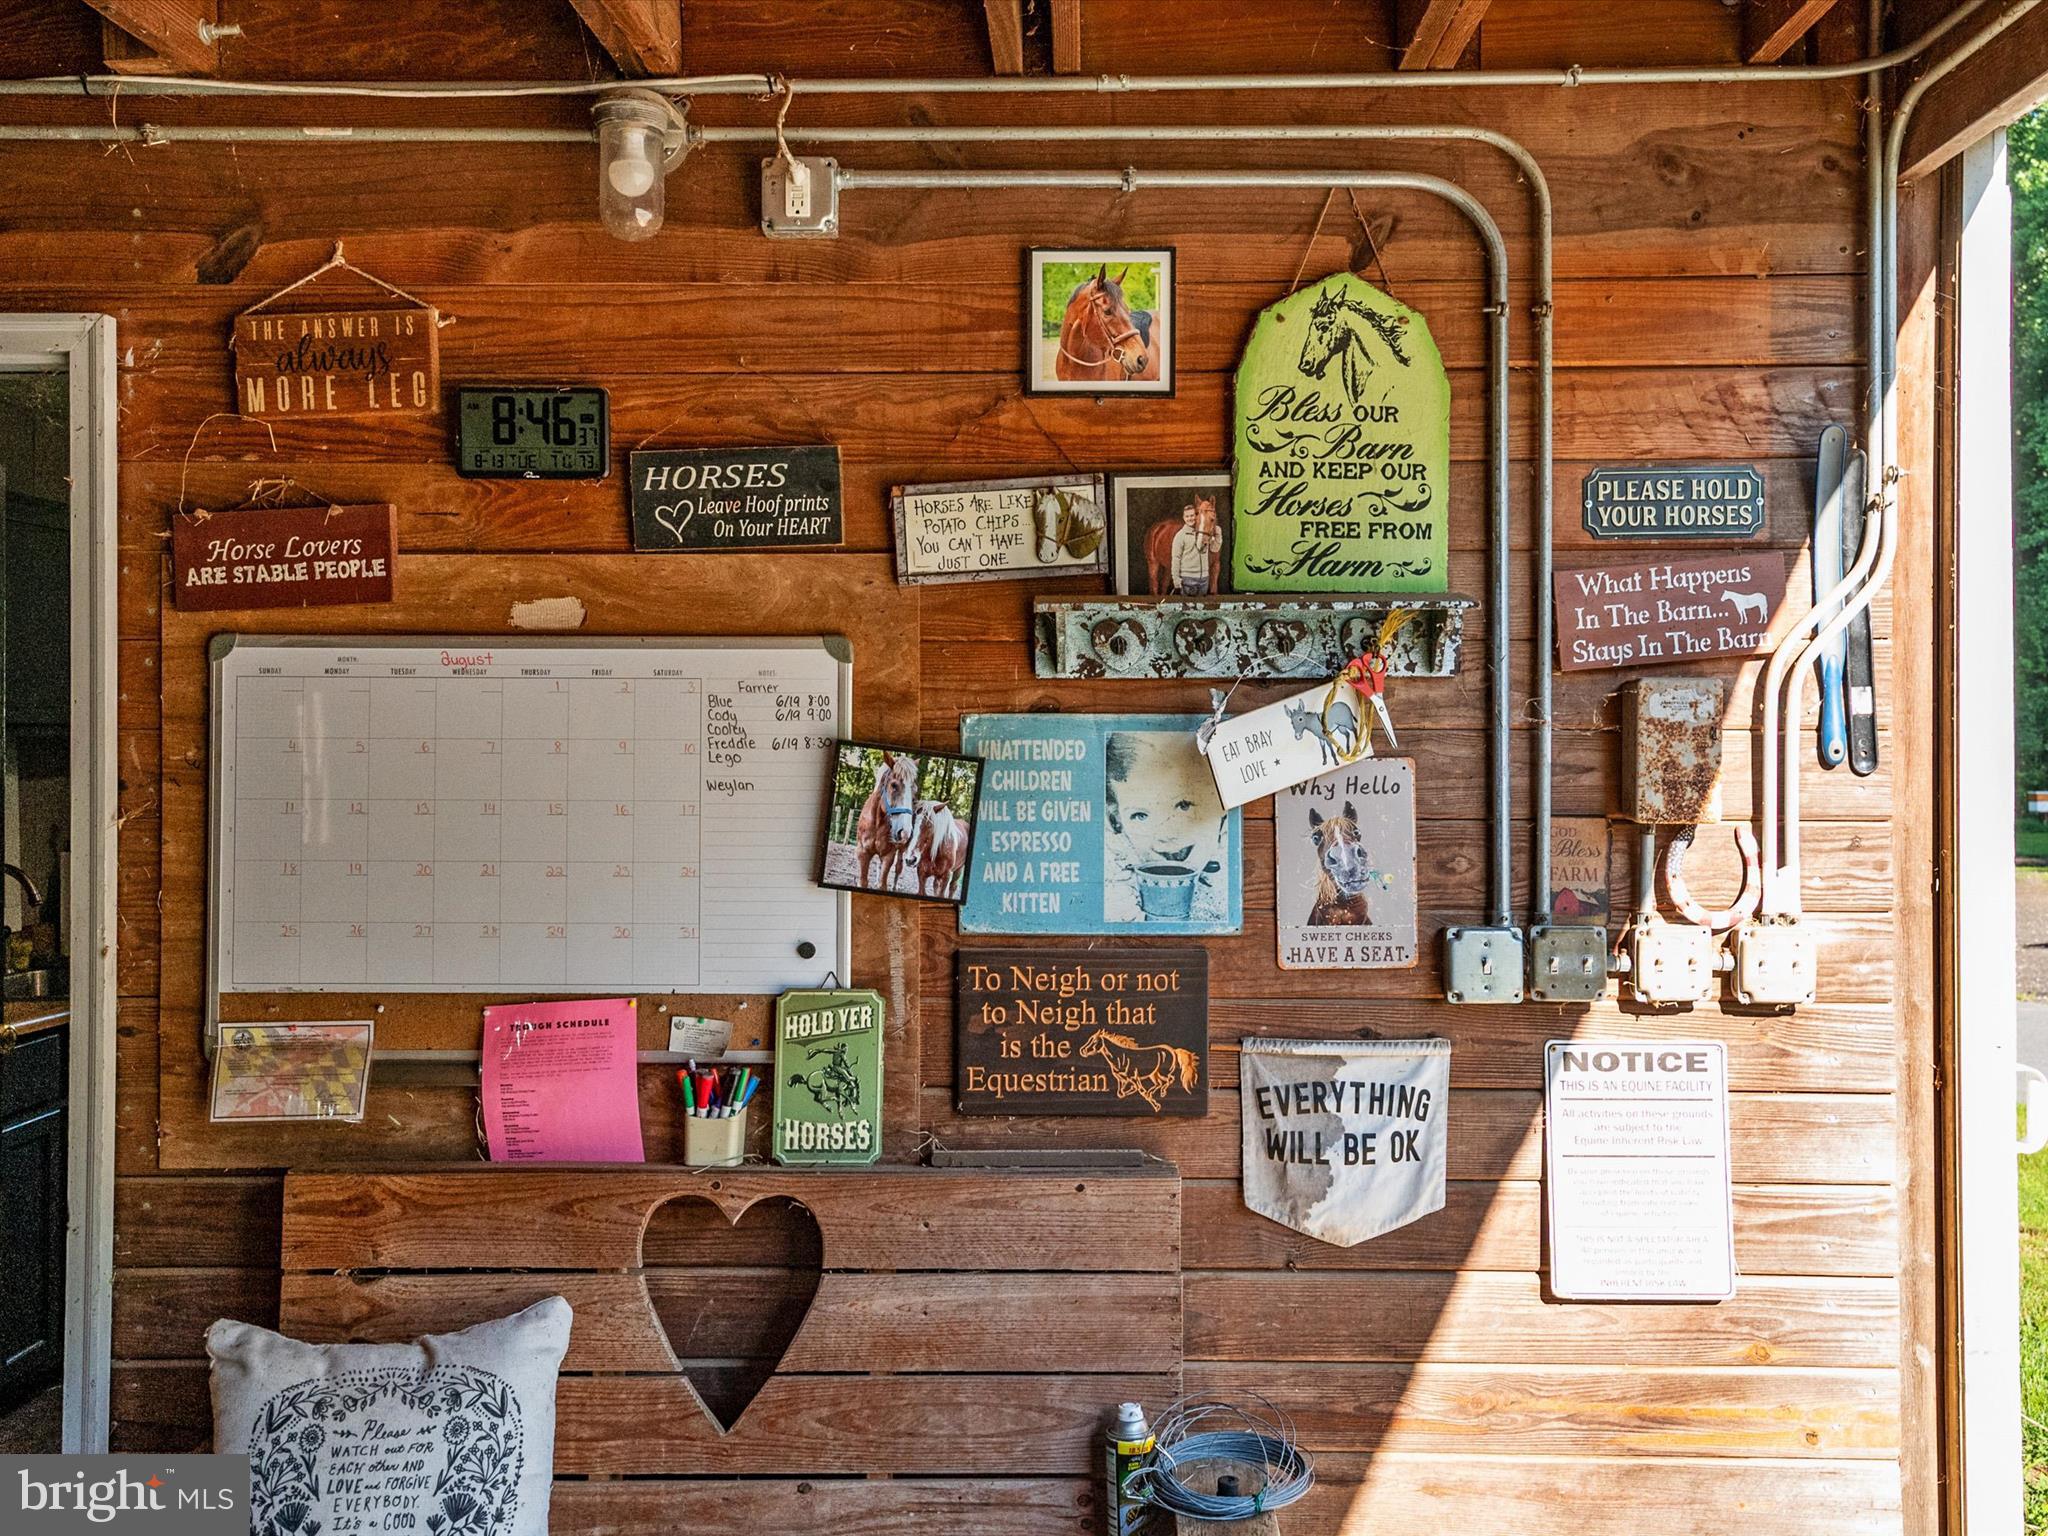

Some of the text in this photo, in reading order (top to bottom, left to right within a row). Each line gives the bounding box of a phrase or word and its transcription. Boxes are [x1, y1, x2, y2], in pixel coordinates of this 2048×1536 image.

[251, 316, 415, 341] THE ANSWER IS
[275, 333, 393, 381] always
[246, 370, 427, 413] MORE LEG
[1246, 384, 1399, 423] Bless OUR
[492, 396, 576, 445] 8:46
[1312, 423, 1415, 460] Barn
[474, 454, 504, 468] 8-13
[511, 454, 537, 468] TUE
[1259, 461, 1427, 481] AND KEEP OUR
[643, 462, 789, 491] HORSES
[1244, 480, 1354, 517] Horses
[1597, 478, 1752, 501] PLEASE HOLD
[697, 494, 829, 518] Leave Hoof prints
[914, 493, 1033, 518] HORSES ARE LIKE
[1597, 505, 1752, 527] YOUR HORSES
[713, 516, 831, 538] On Your HEART
[924, 518, 967, 535] POTATO
[1300, 521, 1432, 540] FREE FROM
[207, 535, 362, 563] Horse Lovers
[916, 532, 1024, 556] YOU CAN'T HAVE
[938, 552, 1009, 571] JUST ONE
[1285, 540, 1385, 578] Harm
[186, 557, 386, 587] ARE STABLE PEOPLE
[1575, 565, 1751, 597] What Happens
[1575, 607, 1600, 630] In
[1603, 603, 1650, 628] The
[1572, 626, 1773, 666] Stays In The Barn
[707, 694, 830, 708] Blue 6/19 8:00
[707, 708, 832, 725] Cody 6/19 9:00
[707, 736, 832, 751] Freddie 6/19 8:30
[978, 739, 1086, 761] UNATTENDED
[1221, 729, 1275, 762] EAT BRAY
[708, 751, 742, 768] Lego
[991, 770, 1072, 791] CHILDREN
[1240, 760, 1267, 784] LOVE
[706, 779, 755, 797] Weylan
[1290, 775, 1401, 800] Why Hello
[1016, 800, 1037, 822] BE
[1043, 798, 1091, 822] GIVEN
[991, 831, 1072, 853] ESPRESSO
[1551, 838, 1601, 857] Bless
[982, 862, 1080, 883] AND A FREE
[1002, 892, 1061, 914] KITTEN
[1301, 931, 1393, 942] SWEET CHEEKS
[1290, 946, 1405, 964] HAVE A SEAT
[967, 965, 1181, 998] To Neigh or not
[556, 1018, 610, 1030] SCHEDULE
[785, 1005, 873, 1040] HOLD YER
[981, 999, 1157, 1032] to Neigh that
[1000, 1032, 1072, 1059] is the
[1562, 1052, 1709, 1073] NOTICE
[966, 1066, 1110, 1099] Equestrian
[1560, 1080, 1712, 1093] THIS IS AN EQUINE FACILITY
[1256, 1081, 1431, 1122] EVERYTHING
[784, 1118, 872, 1150] HORSES
[1265, 1127, 1421, 1166] WILL BE OK
[362, 1419, 411, 1440] Please
[331, 1442, 434, 1458] WATCH out FOR
[329, 1460, 424, 1475] EACH other AND
[327, 1478, 363, 1494] LOVE
[385, 1474, 431, 1490] FORGIVE
[332, 1516, 362, 1531] It's
[384, 1512, 416, 1531] GOOD
